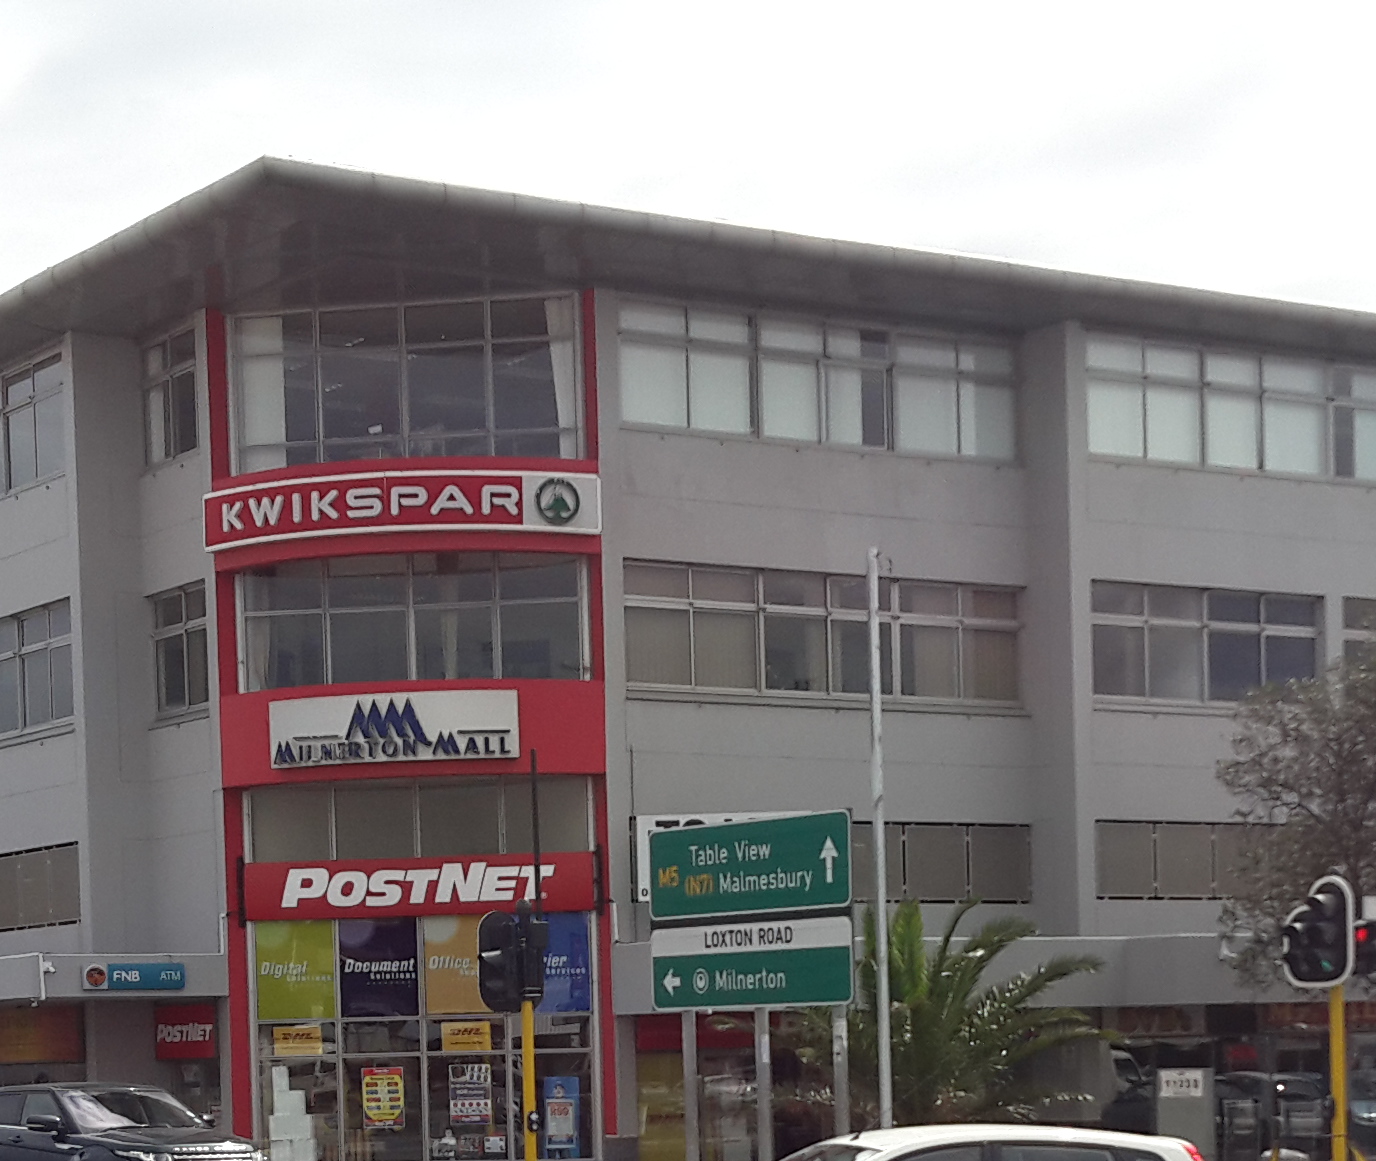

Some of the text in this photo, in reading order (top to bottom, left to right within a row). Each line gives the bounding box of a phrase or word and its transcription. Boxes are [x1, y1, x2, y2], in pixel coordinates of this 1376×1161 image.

[221, 484, 520, 533] KWIKSPAR
[273, 730, 512, 765] MILNERTON MALL
[687, 840, 771, 867] Table View
[658, 865, 680, 888] M5
[719, 866, 813, 895] Malmesbury
[704, 925, 794, 949] LOXTON ROAD
[261, 960, 309, 979] Digital
[344, 957, 415, 974] Document
[428, 954, 471, 970] Office
[112, 969, 182, 983] FNB ATM
[714, 967, 786, 991] Milnerton
